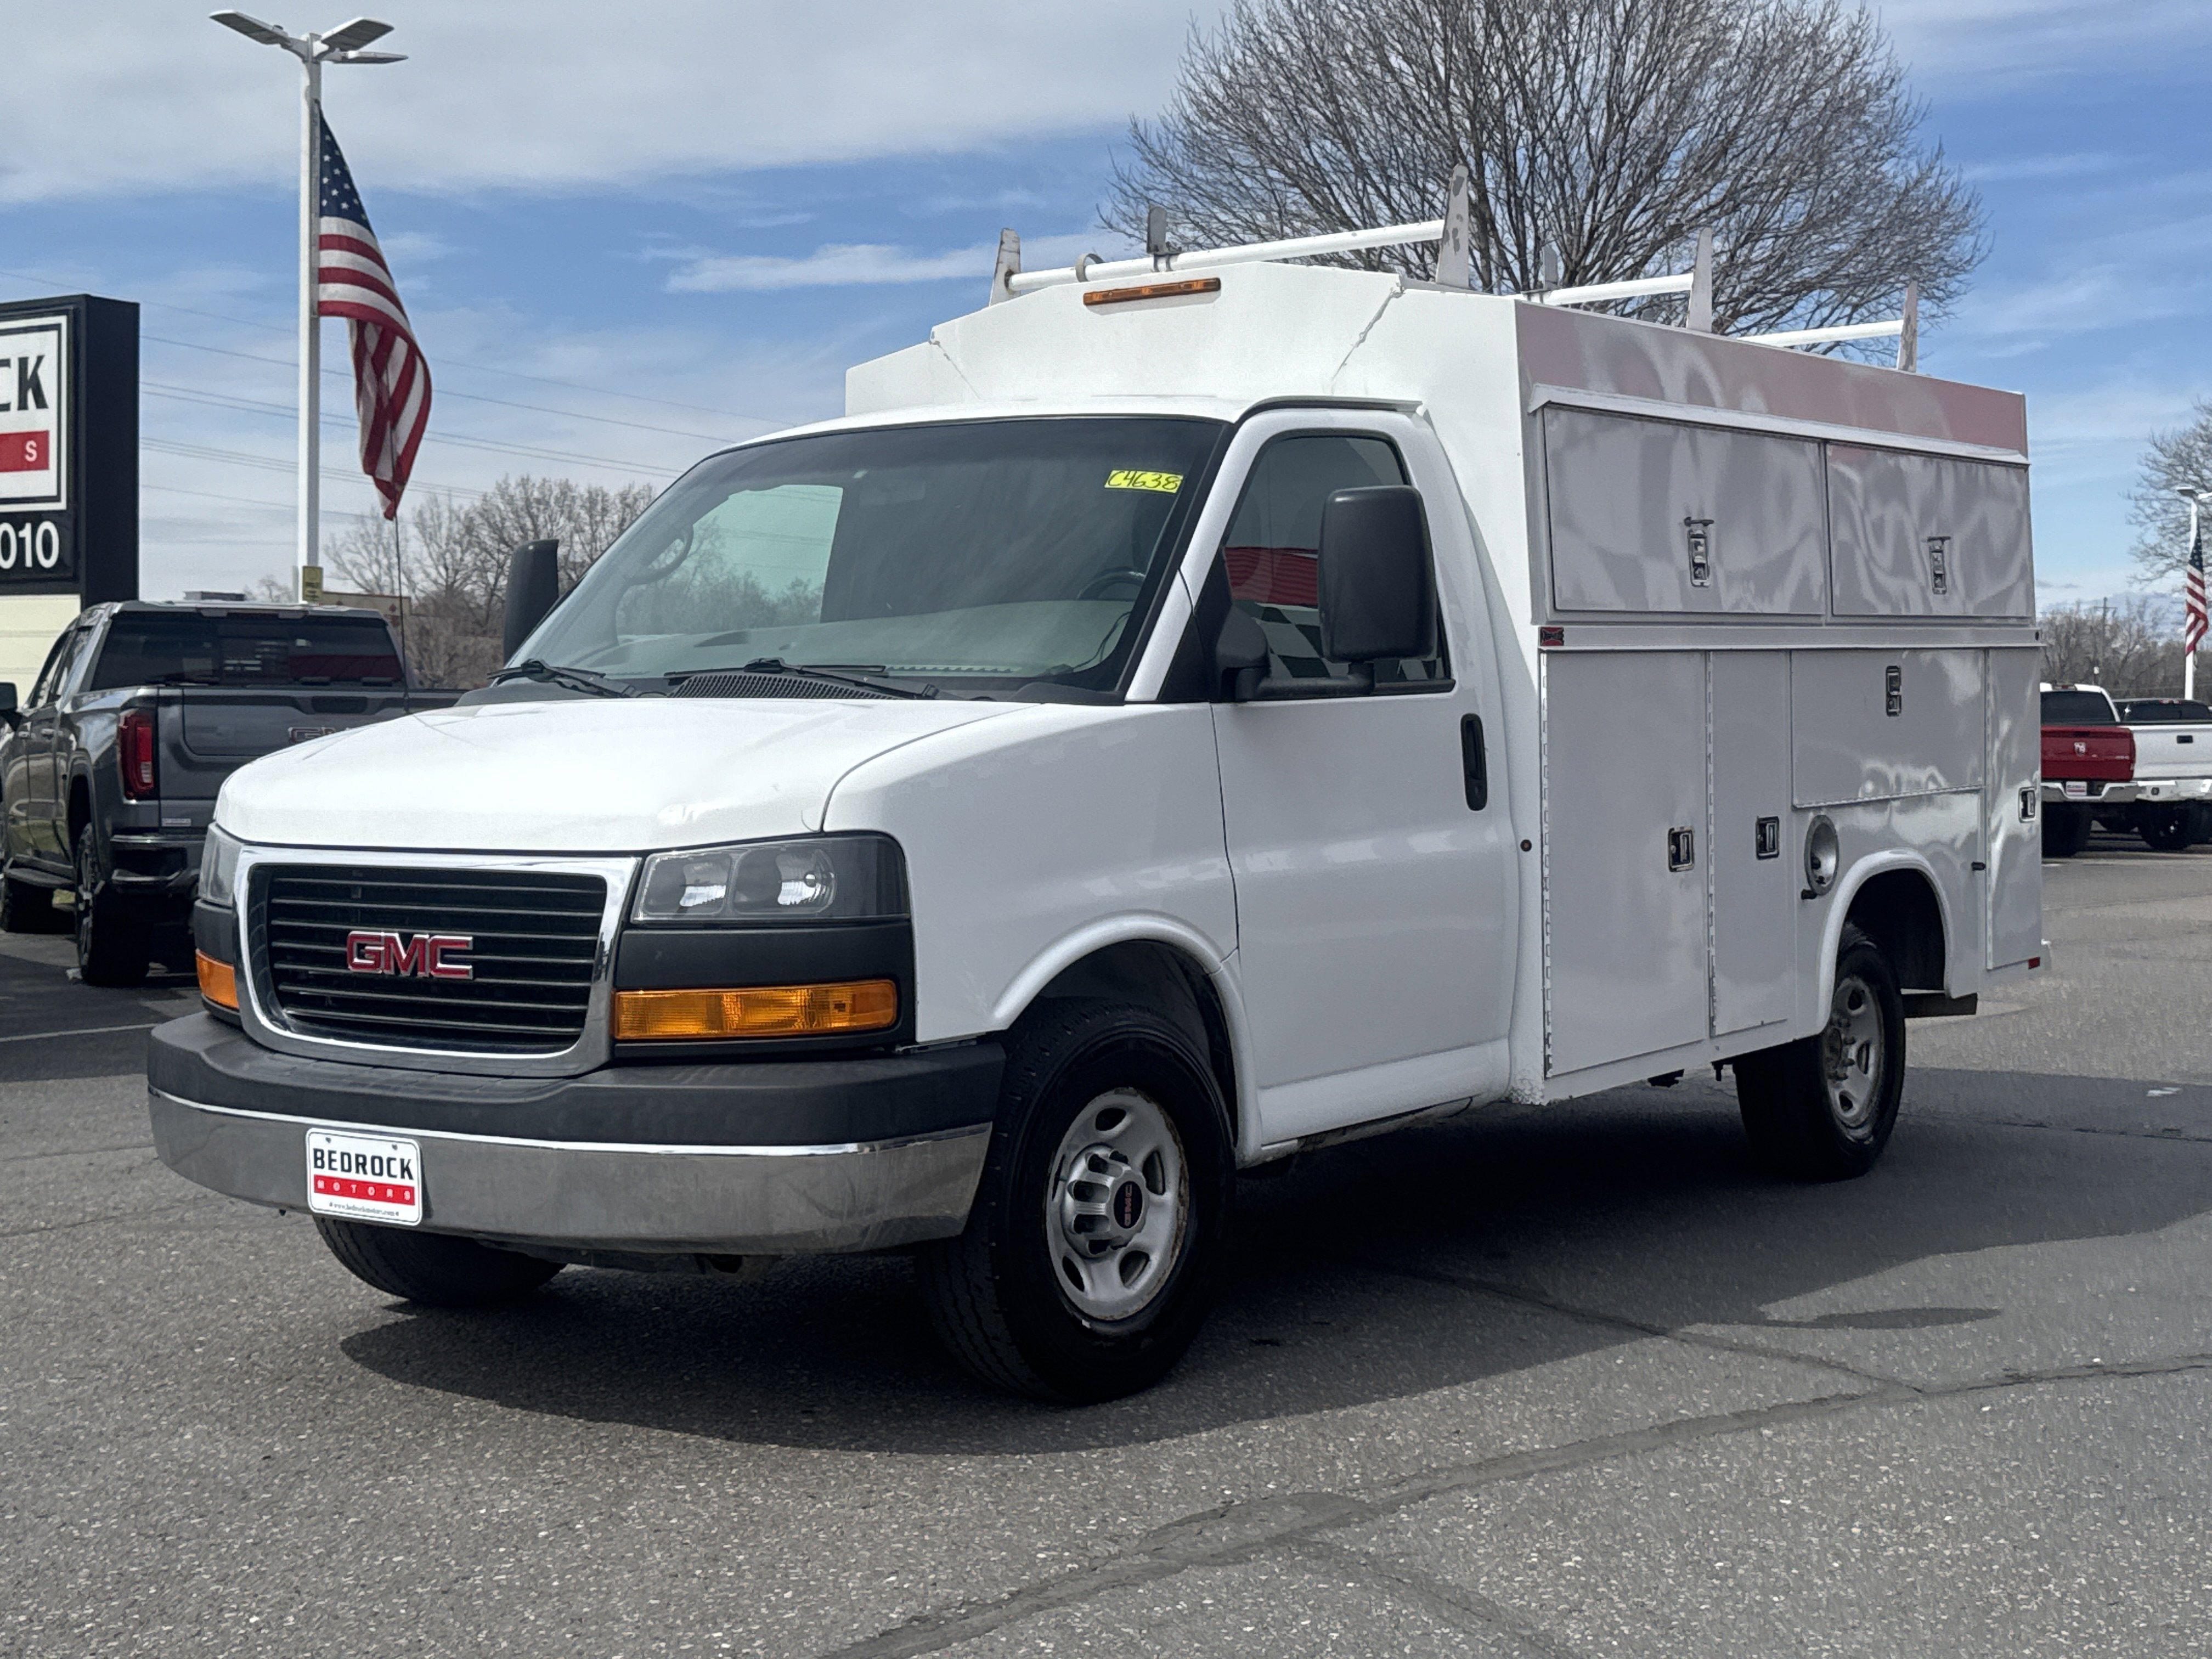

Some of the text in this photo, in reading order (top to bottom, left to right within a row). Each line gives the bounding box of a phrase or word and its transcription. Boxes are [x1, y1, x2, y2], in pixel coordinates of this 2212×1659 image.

[25, 441, 37, 462] S
[346, 931, 473, 980] GMC
[313, 1148, 414, 1180] BEDROCK
[317, 1180, 410, 1200] MOTORS
